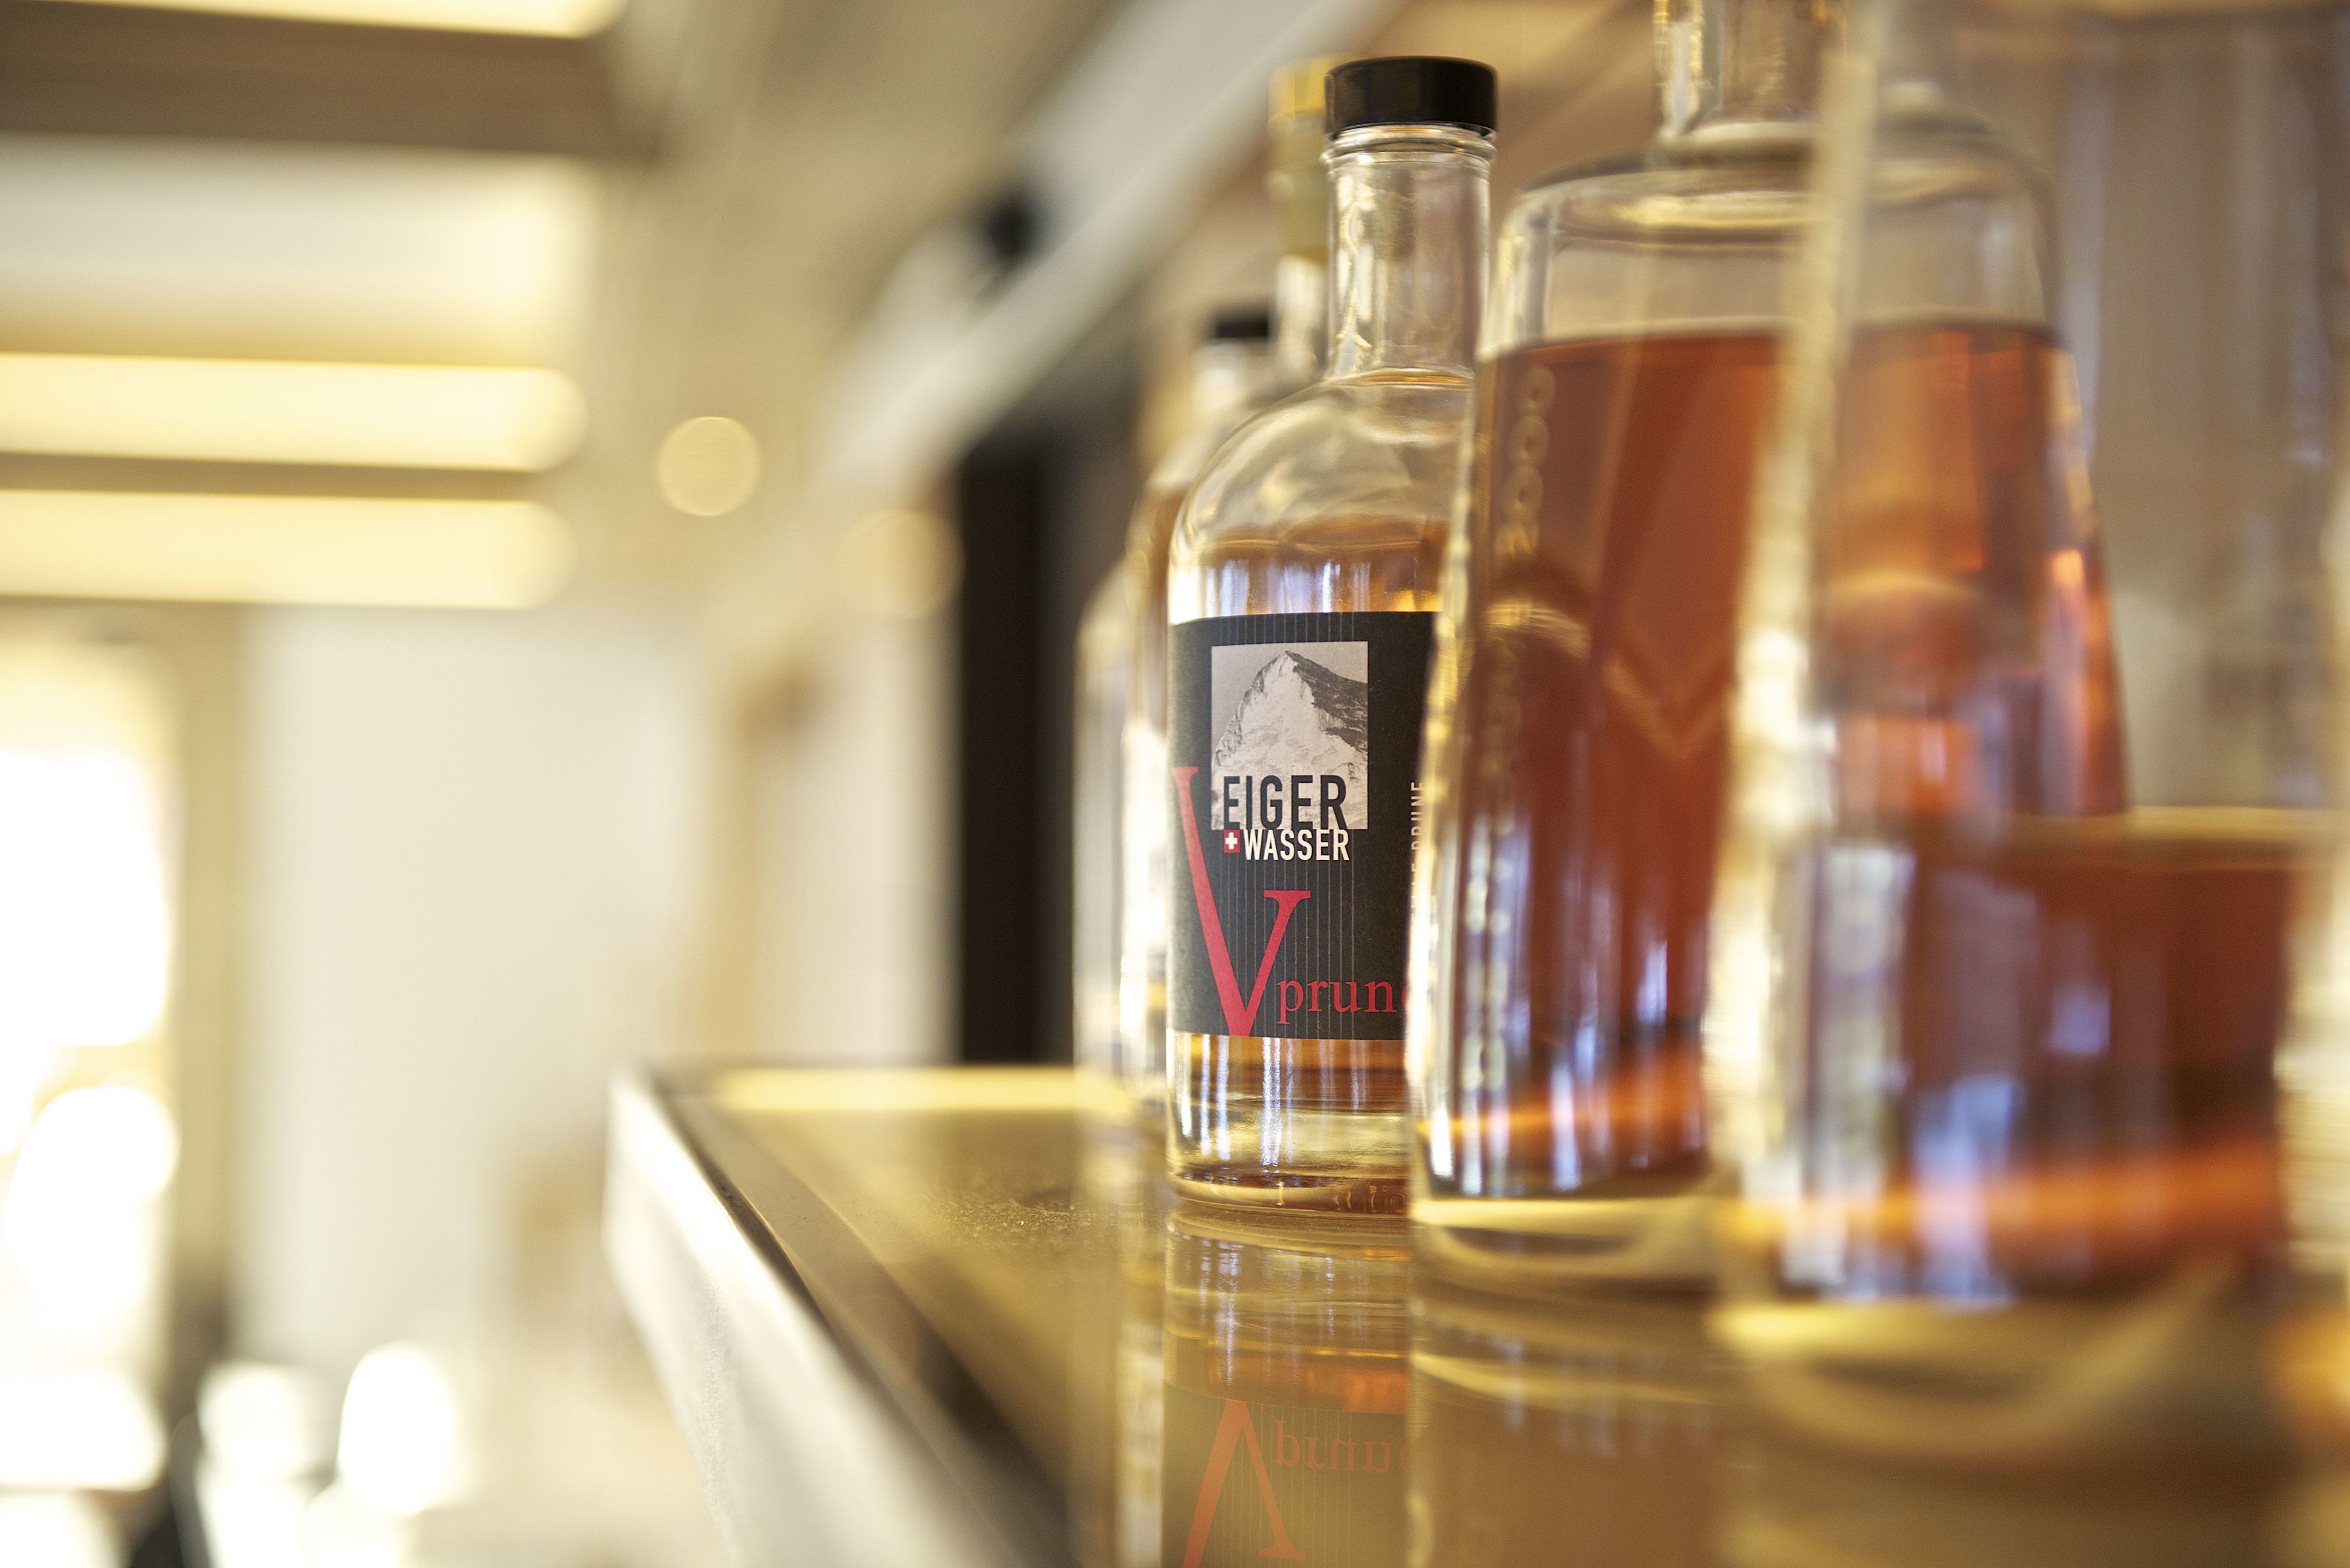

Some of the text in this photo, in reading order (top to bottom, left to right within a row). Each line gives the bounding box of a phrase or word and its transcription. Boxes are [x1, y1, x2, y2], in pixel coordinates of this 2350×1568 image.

[1223, 774, 1348, 829] EIGER
[1243, 829, 1350, 861] WASSER
[1276, 979, 1408, 1025] prun
